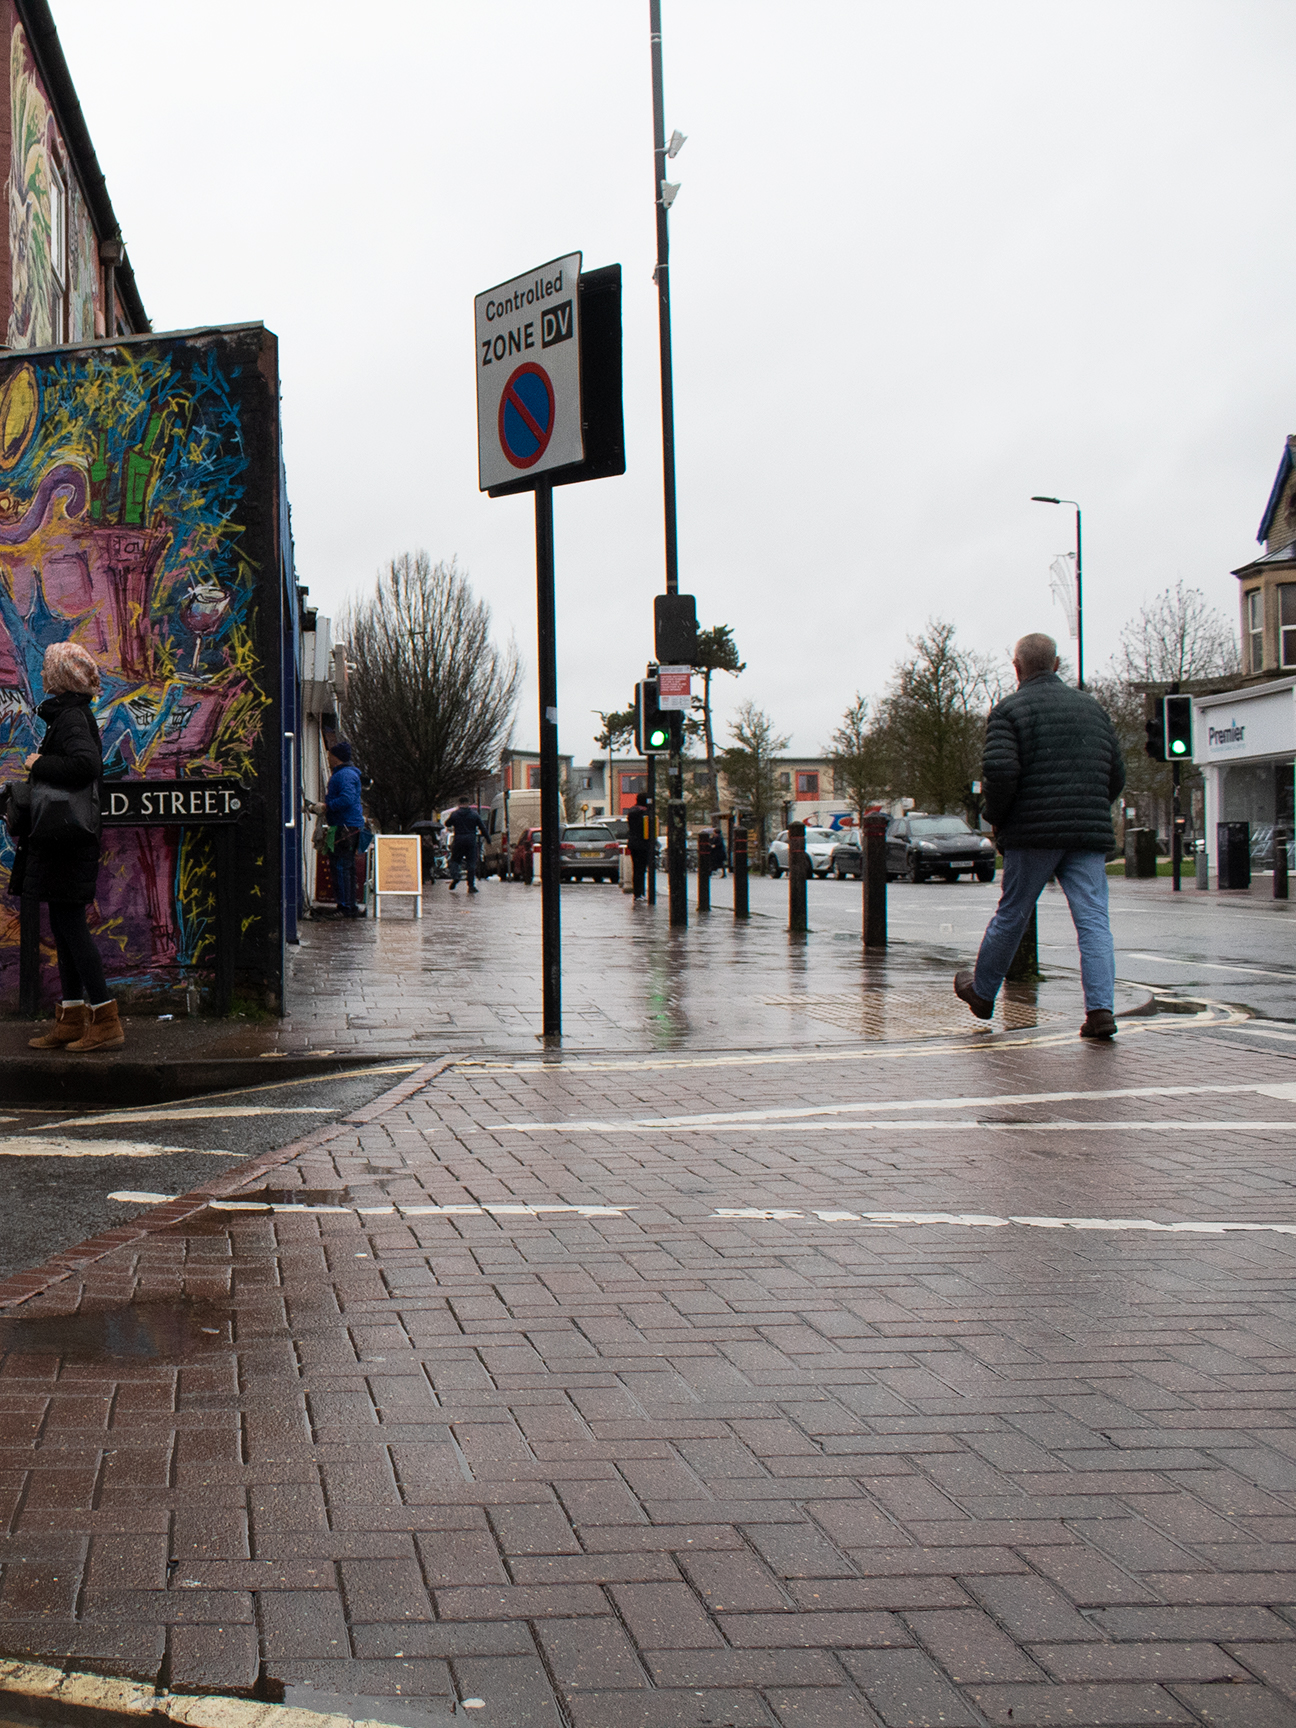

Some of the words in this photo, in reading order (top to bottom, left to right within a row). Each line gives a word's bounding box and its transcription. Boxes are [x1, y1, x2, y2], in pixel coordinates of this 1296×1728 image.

[485, 269, 564, 322] Controlled
[482, 321, 536, 367] ZONE
[541, 305, 572, 345] DV
[1208, 723, 1246, 746] Premier
[141, 790, 236, 815] STREET
